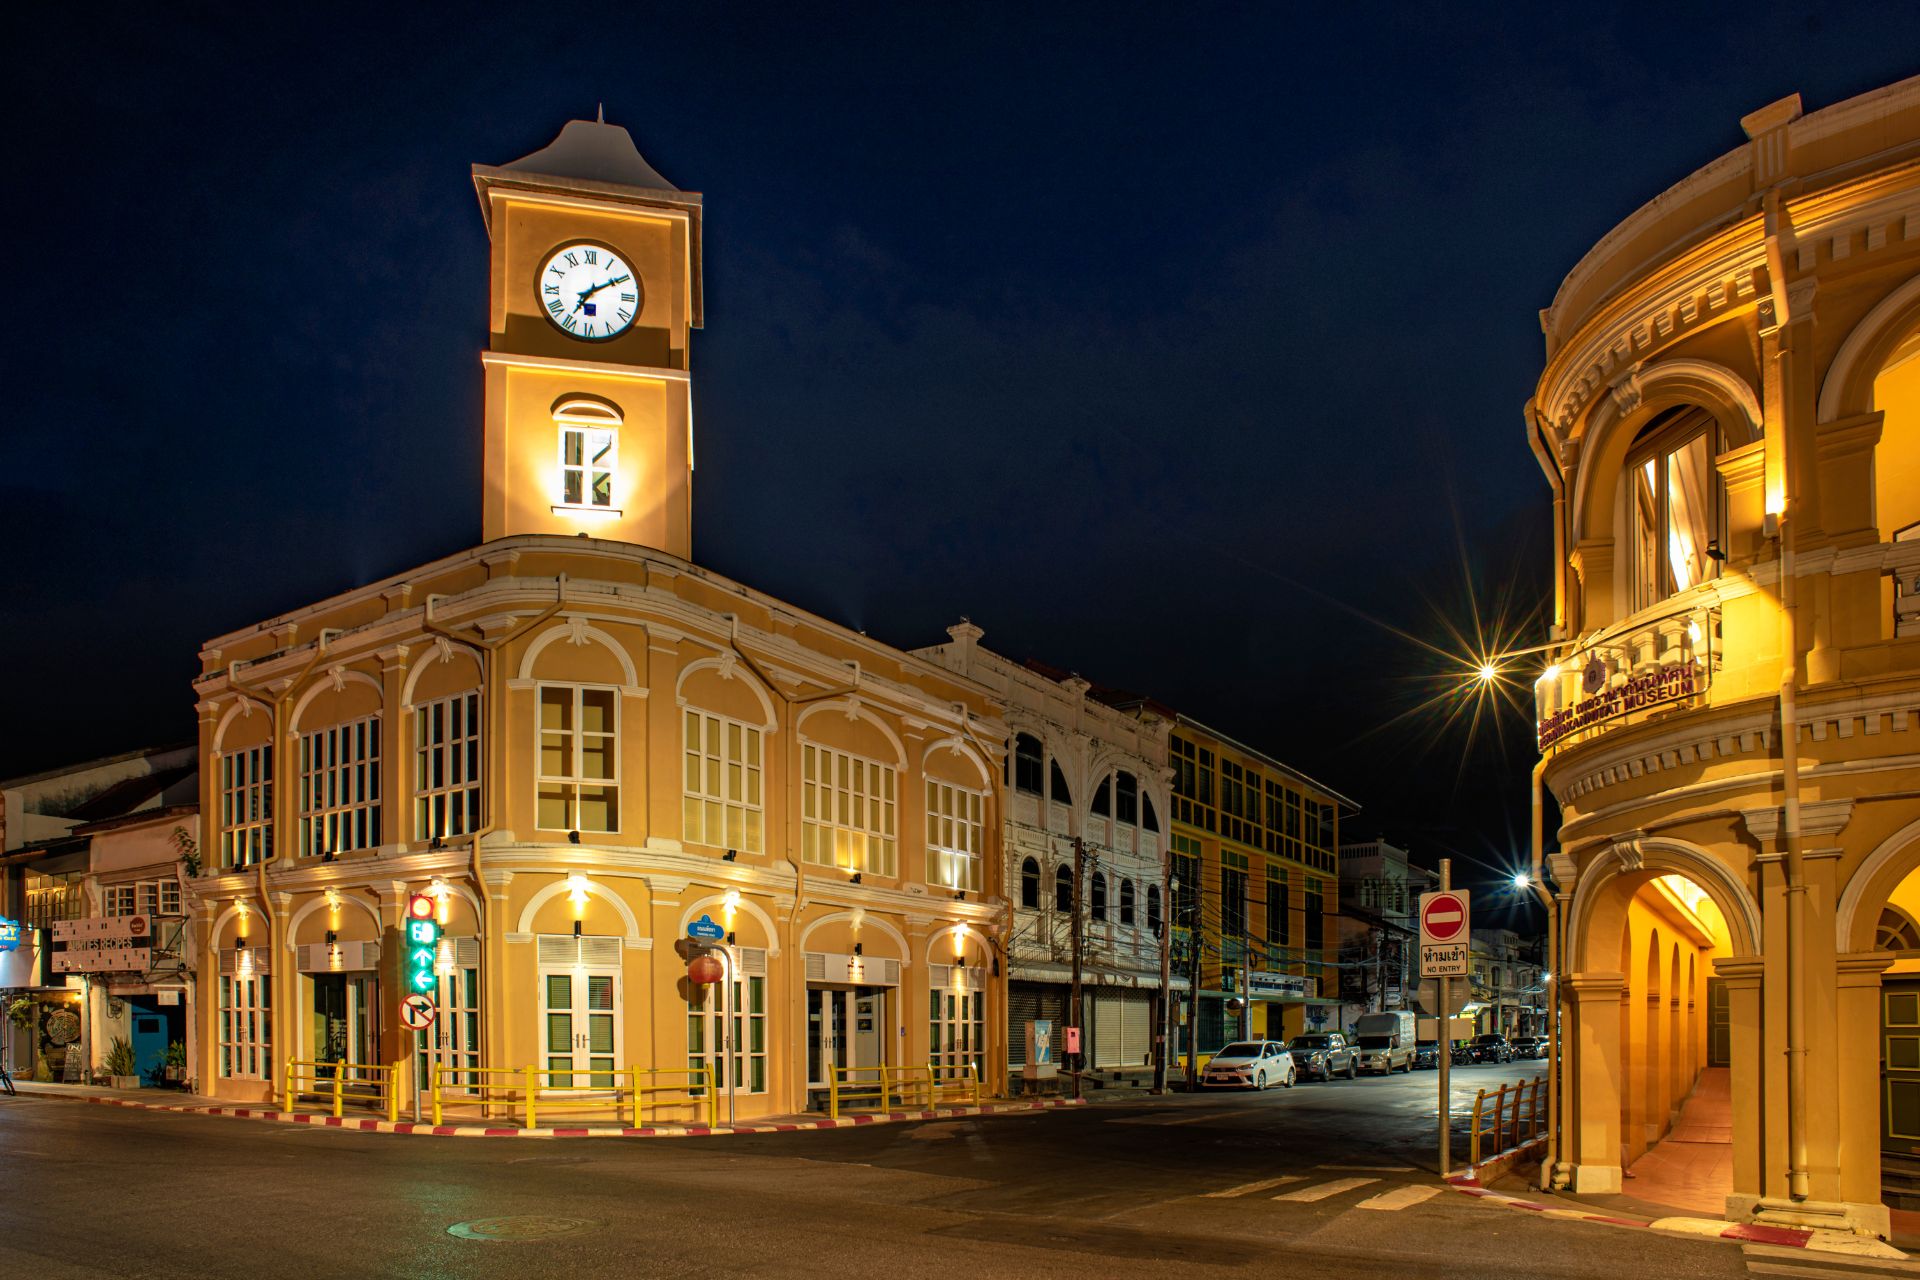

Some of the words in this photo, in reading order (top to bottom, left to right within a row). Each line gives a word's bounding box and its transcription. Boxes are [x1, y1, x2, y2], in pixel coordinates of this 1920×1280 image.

[564, 252, 579, 268] XI
[584, 250, 598, 266] XII
[605, 258, 614, 270] I
[550, 265, 565, 279] X
[544, 284, 560, 295] IX
[621, 293, 636, 303] III
[548, 299, 565, 318] VIII
[616, 308, 631, 323] IV
[562, 314, 577, 332] VII
[584, 322, 596, 337] VI
[605, 321, 616, 334] V
[1624, 680, 1694, 710] MUSEUM
[101, 937, 132, 950] RECIPES
[1424, 946, 1465, 962] ห้ามเข้า
